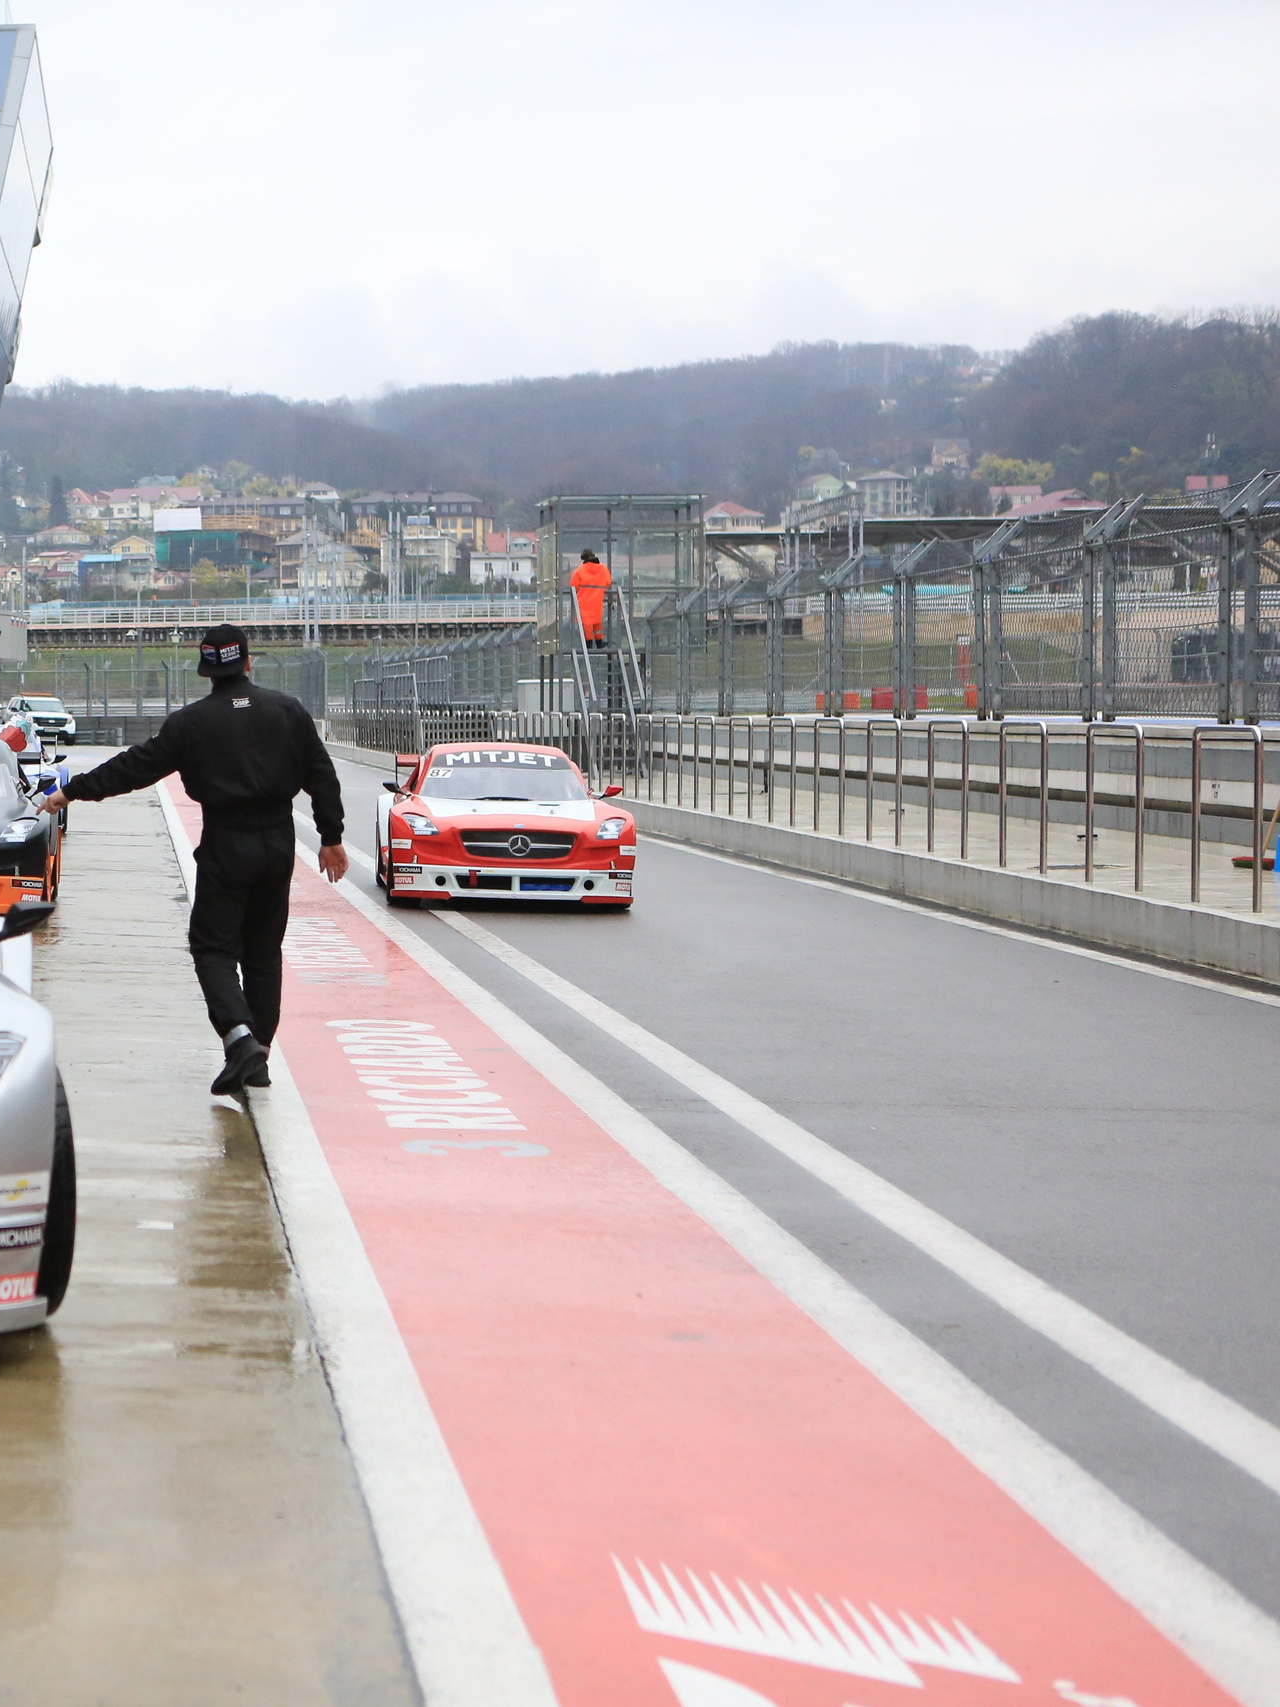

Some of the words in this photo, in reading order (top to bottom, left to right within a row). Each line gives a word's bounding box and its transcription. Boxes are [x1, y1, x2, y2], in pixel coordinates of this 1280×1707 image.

[445, 751, 557, 767] MITJET
[429, 769, 452, 777] 87
[325, 1019, 528, 1131] RICCIARDO
[399, 1139, 551, 1158] 3
